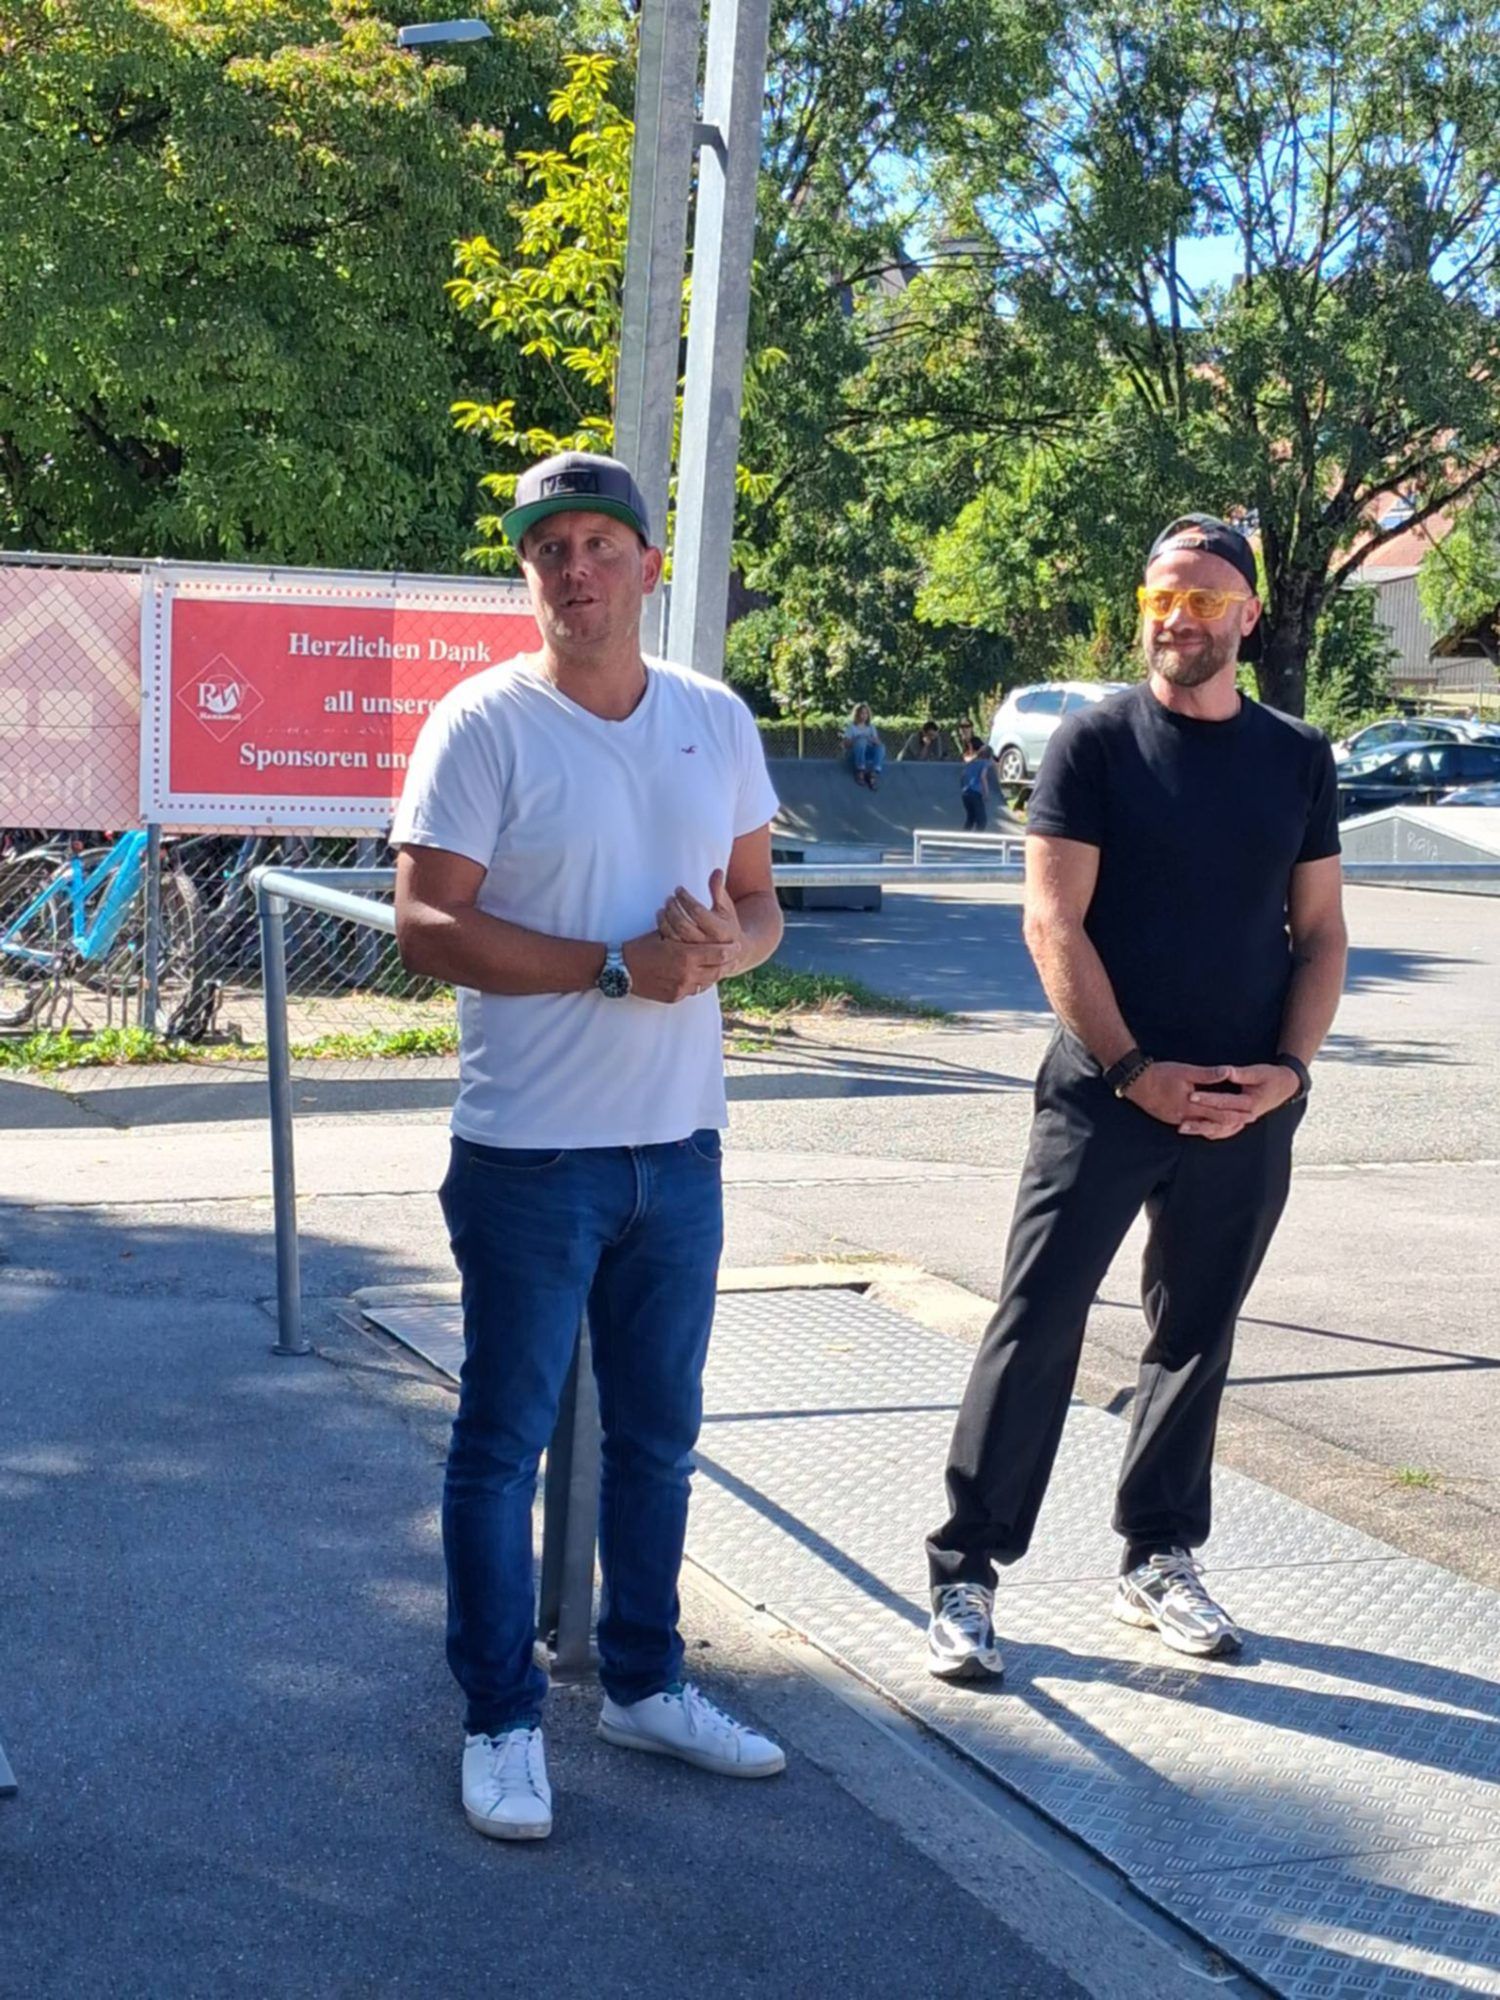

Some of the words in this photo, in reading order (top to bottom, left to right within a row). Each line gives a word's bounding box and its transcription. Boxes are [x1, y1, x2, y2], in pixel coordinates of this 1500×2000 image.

[288, 632, 420, 660] Herzlichen
[428, 638, 491, 663] Dank
[324, 690, 353, 713] all
[239, 742, 368, 771] Sponsoren
[376, 752, 410, 770] un
